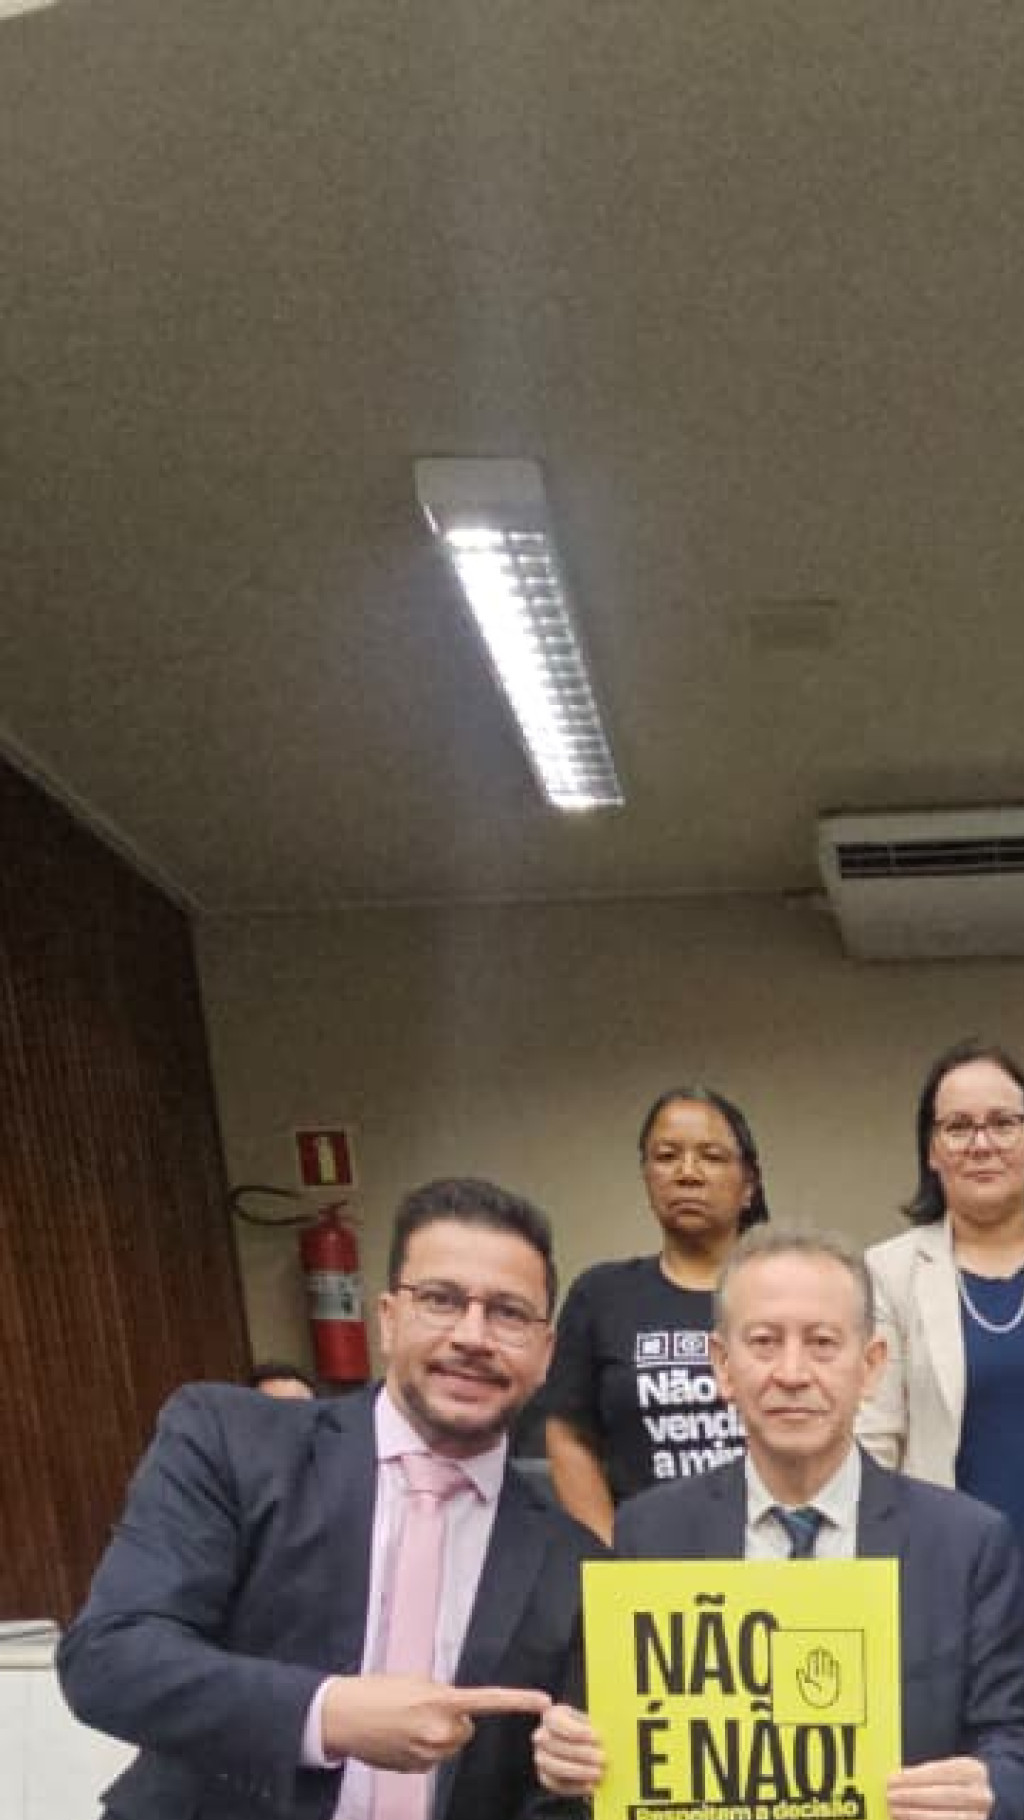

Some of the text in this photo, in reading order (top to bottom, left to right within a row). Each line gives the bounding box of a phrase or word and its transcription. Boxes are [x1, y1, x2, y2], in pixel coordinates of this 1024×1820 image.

[636, 1366, 717, 1408] Não
[641, 1404, 747, 1442] vend
[653, 1450, 676, 1479] a
[633, 1592, 778, 1695] NÃO
[636, 1700, 860, 1806] É NÃO!
[772, 1799, 861, 1820] decisão
